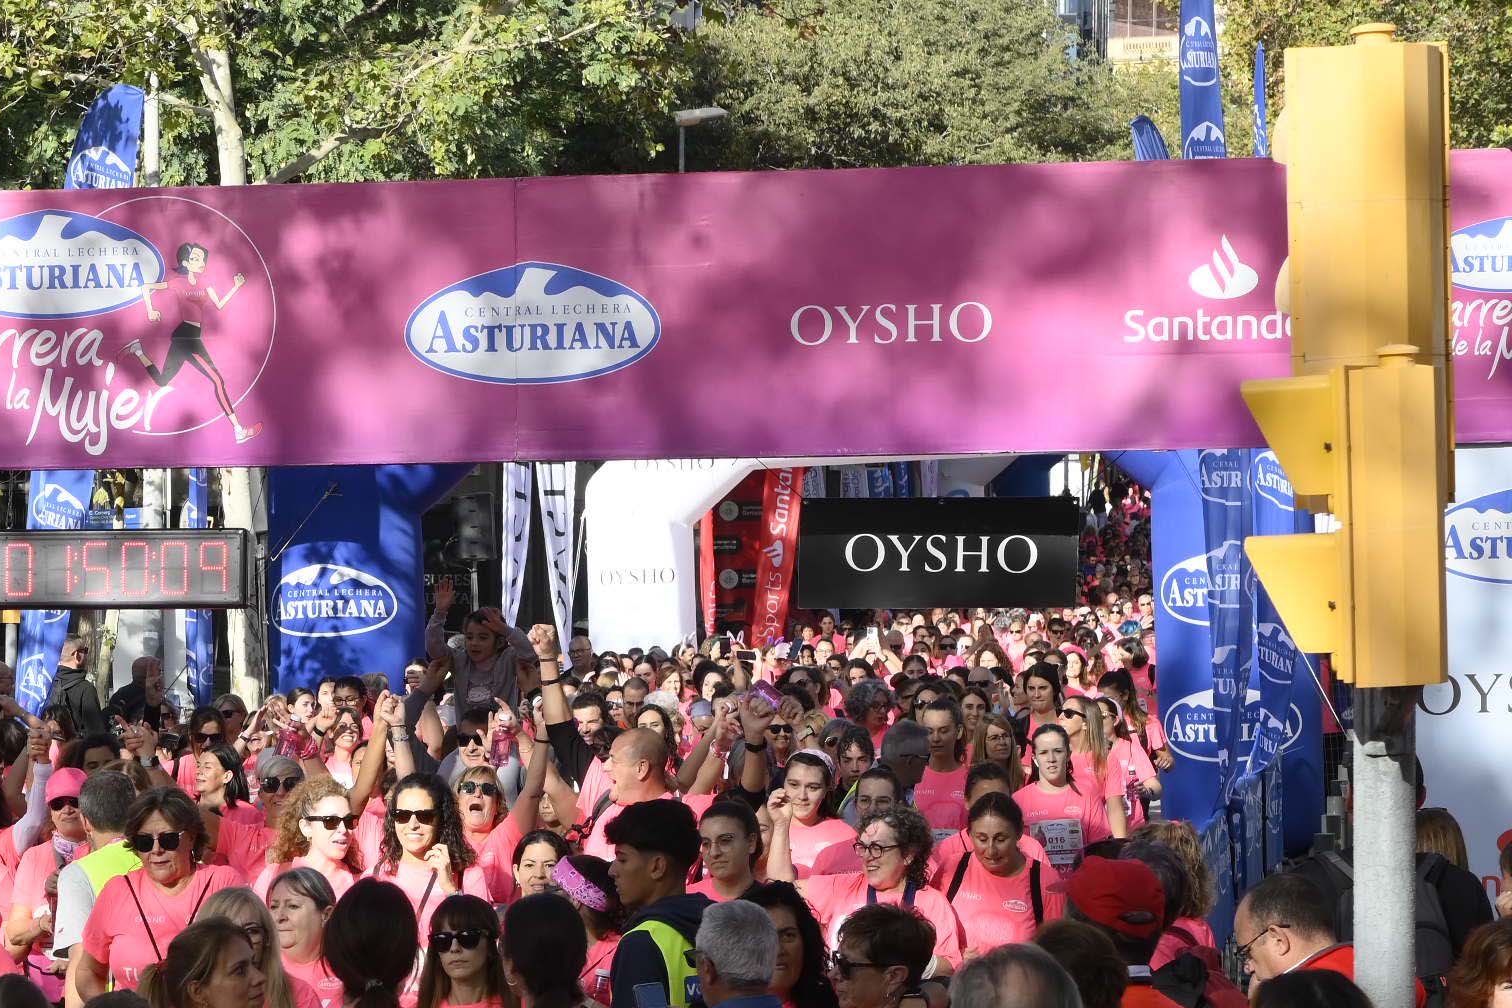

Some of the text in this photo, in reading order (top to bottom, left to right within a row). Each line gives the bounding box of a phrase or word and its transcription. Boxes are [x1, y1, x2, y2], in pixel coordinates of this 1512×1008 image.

[67, 246, 141, 257] LECHERA
[464, 303, 633, 317] CENTRAL LECHERA
[789, 301, 994, 346] OYSHO
[424, 309, 641, 354] ASTURIANA
[5, 373, 31, 410] la
[25, 362, 175, 456] Mujer
[843, 533, 1039, 574] OYSHO
[287, 588, 384, 598] CENTRAL LECHERA
[599, 567, 676, 586] OYSHO
[275, 594, 388, 621] ASTURIANA
[757, 572, 782, 640] Sports
